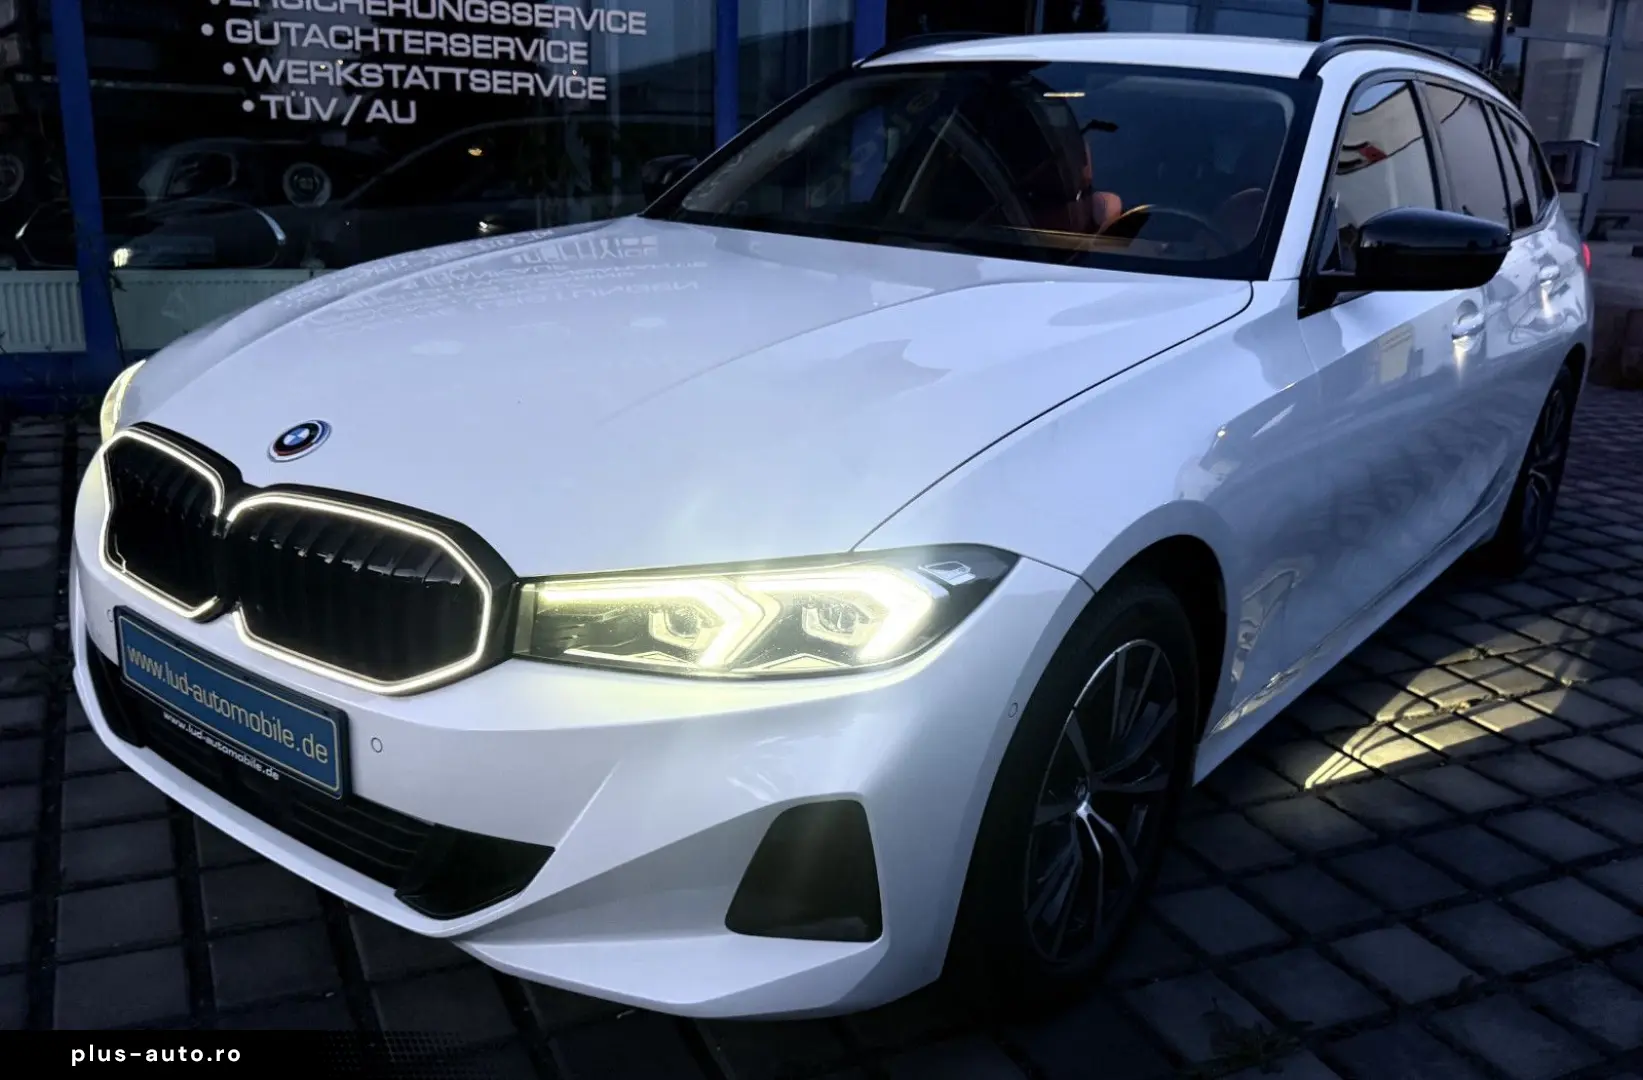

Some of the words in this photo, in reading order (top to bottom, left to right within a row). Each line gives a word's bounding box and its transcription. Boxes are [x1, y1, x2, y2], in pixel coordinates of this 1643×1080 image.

[225, 18, 588, 65] GUTACHTERSERVICE
[242, 56, 606, 100] WERKSTATTSERVICE
[127, 644, 329, 764] www.lud-automobile.de
[163, 711, 280, 781] www.lud-automobile.de
